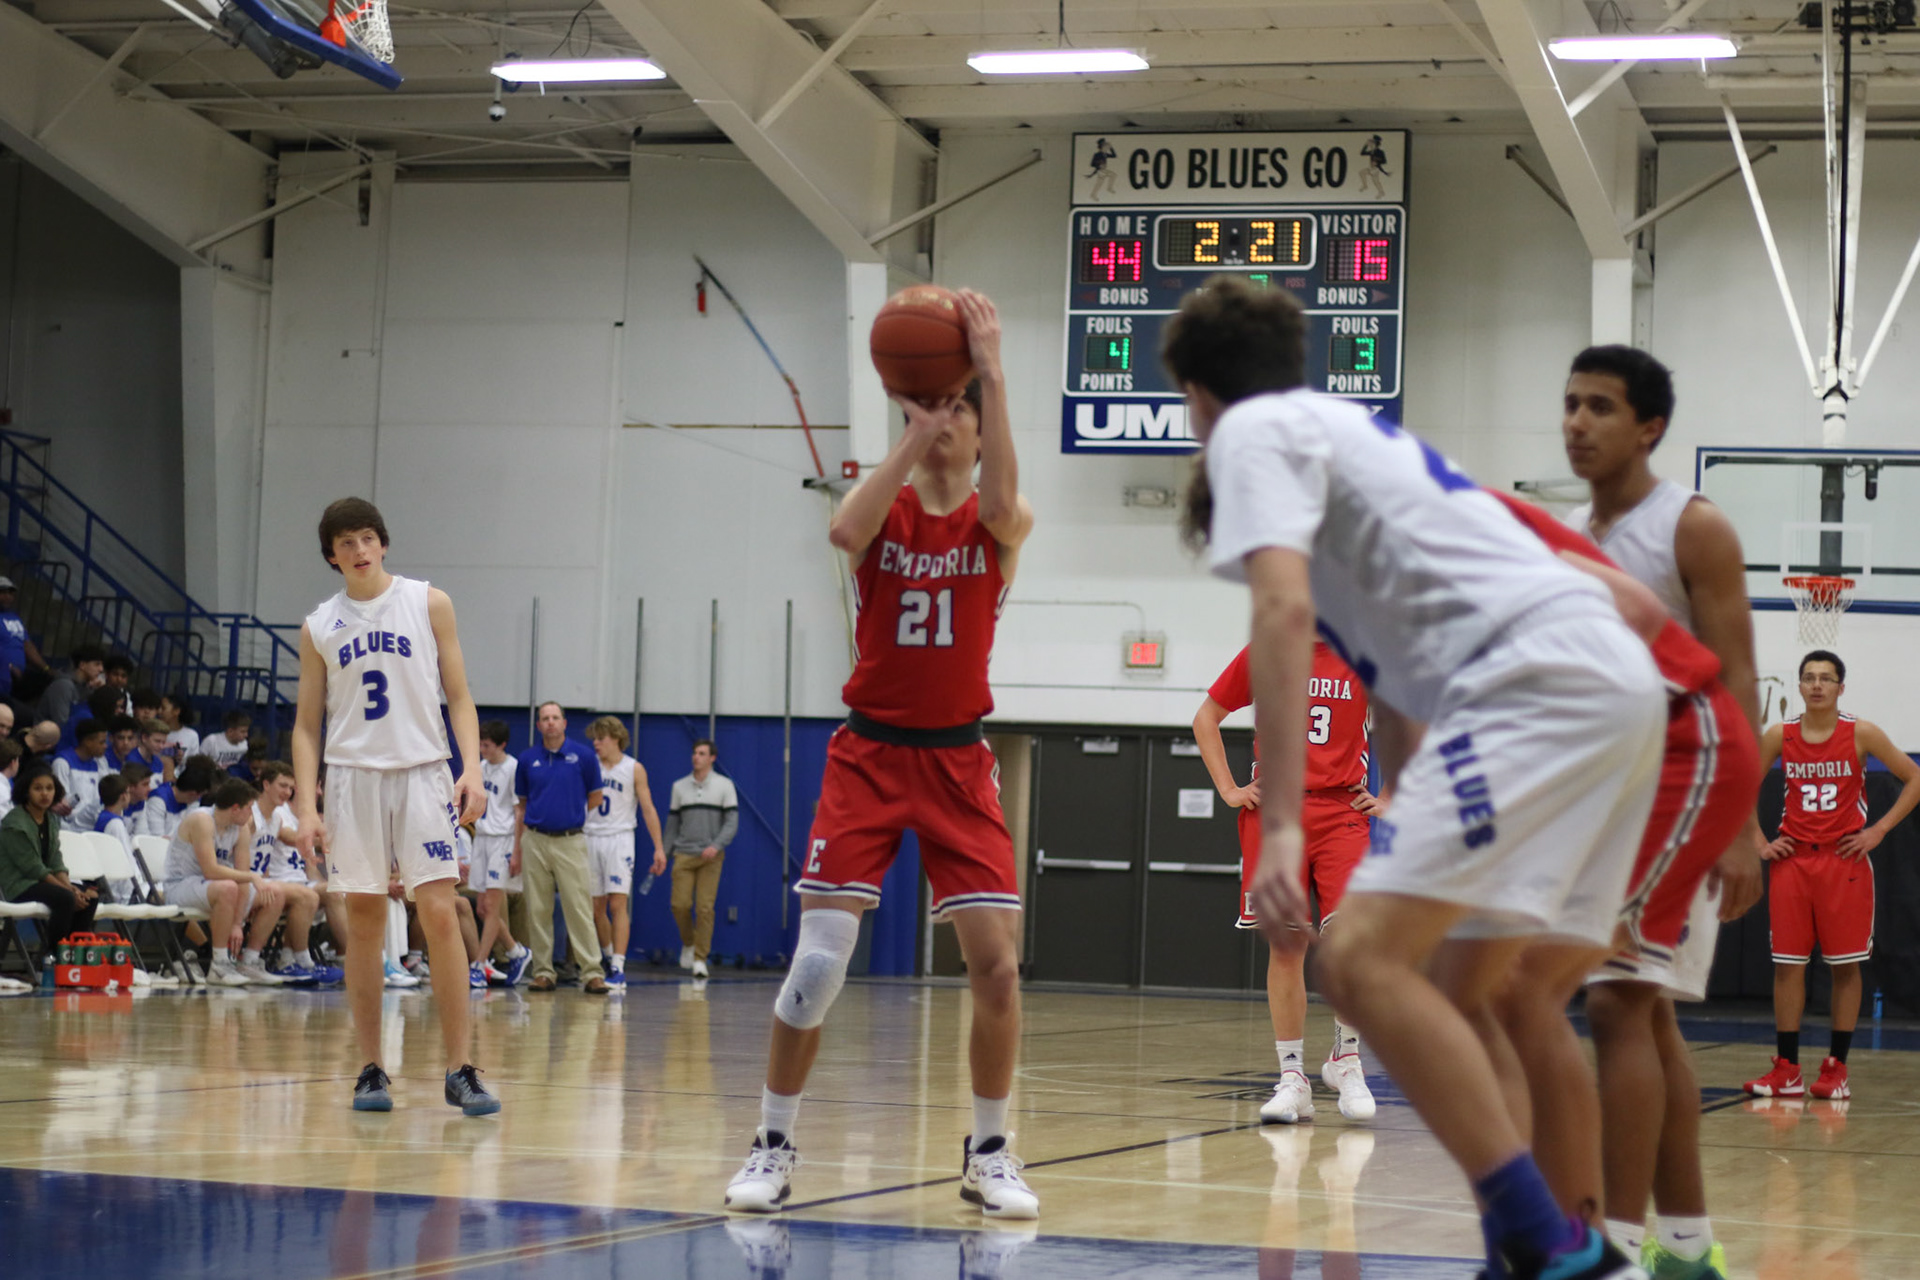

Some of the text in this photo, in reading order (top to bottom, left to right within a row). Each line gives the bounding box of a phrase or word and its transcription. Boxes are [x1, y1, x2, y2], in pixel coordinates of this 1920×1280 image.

[1129, 147, 1348, 190] GO BLUES GO
[1080, 216, 1148, 235] HOME
[1321, 214, 1397, 235] VISITOR
[1091, 240, 1142, 282] 44
[1353, 239, 1389, 281] 15
[1100, 287, 1149, 305] BONUS
[1317, 287, 1368, 305] BONUS
[1086, 317, 1133, 334] FOULS
[1331, 317, 1380, 335] FOULS
[1109, 337, 1130, 370] 4
[1355, 337, 1375, 371] 3
[1080, 373, 1134, 391] POINTS
[1327, 374, 1382, 392] POINTS
[879, 540, 987, 580] EMPORIA
[896, 588, 954, 647] 21
[338, 630, 412, 669] BLUES
[361, 669, 390, 721] 3
[1308, 677, 1353, 700] ORIA
[1786, 760, 1853, 779] EMPORIA
[1438, 731, 1497, 851] BLUES
[1799, 783, 1839, 812] 22
[423, 840, 455, 862] WR
[807, 838, 827, 874] E
[68, 967, 81, 983] G
